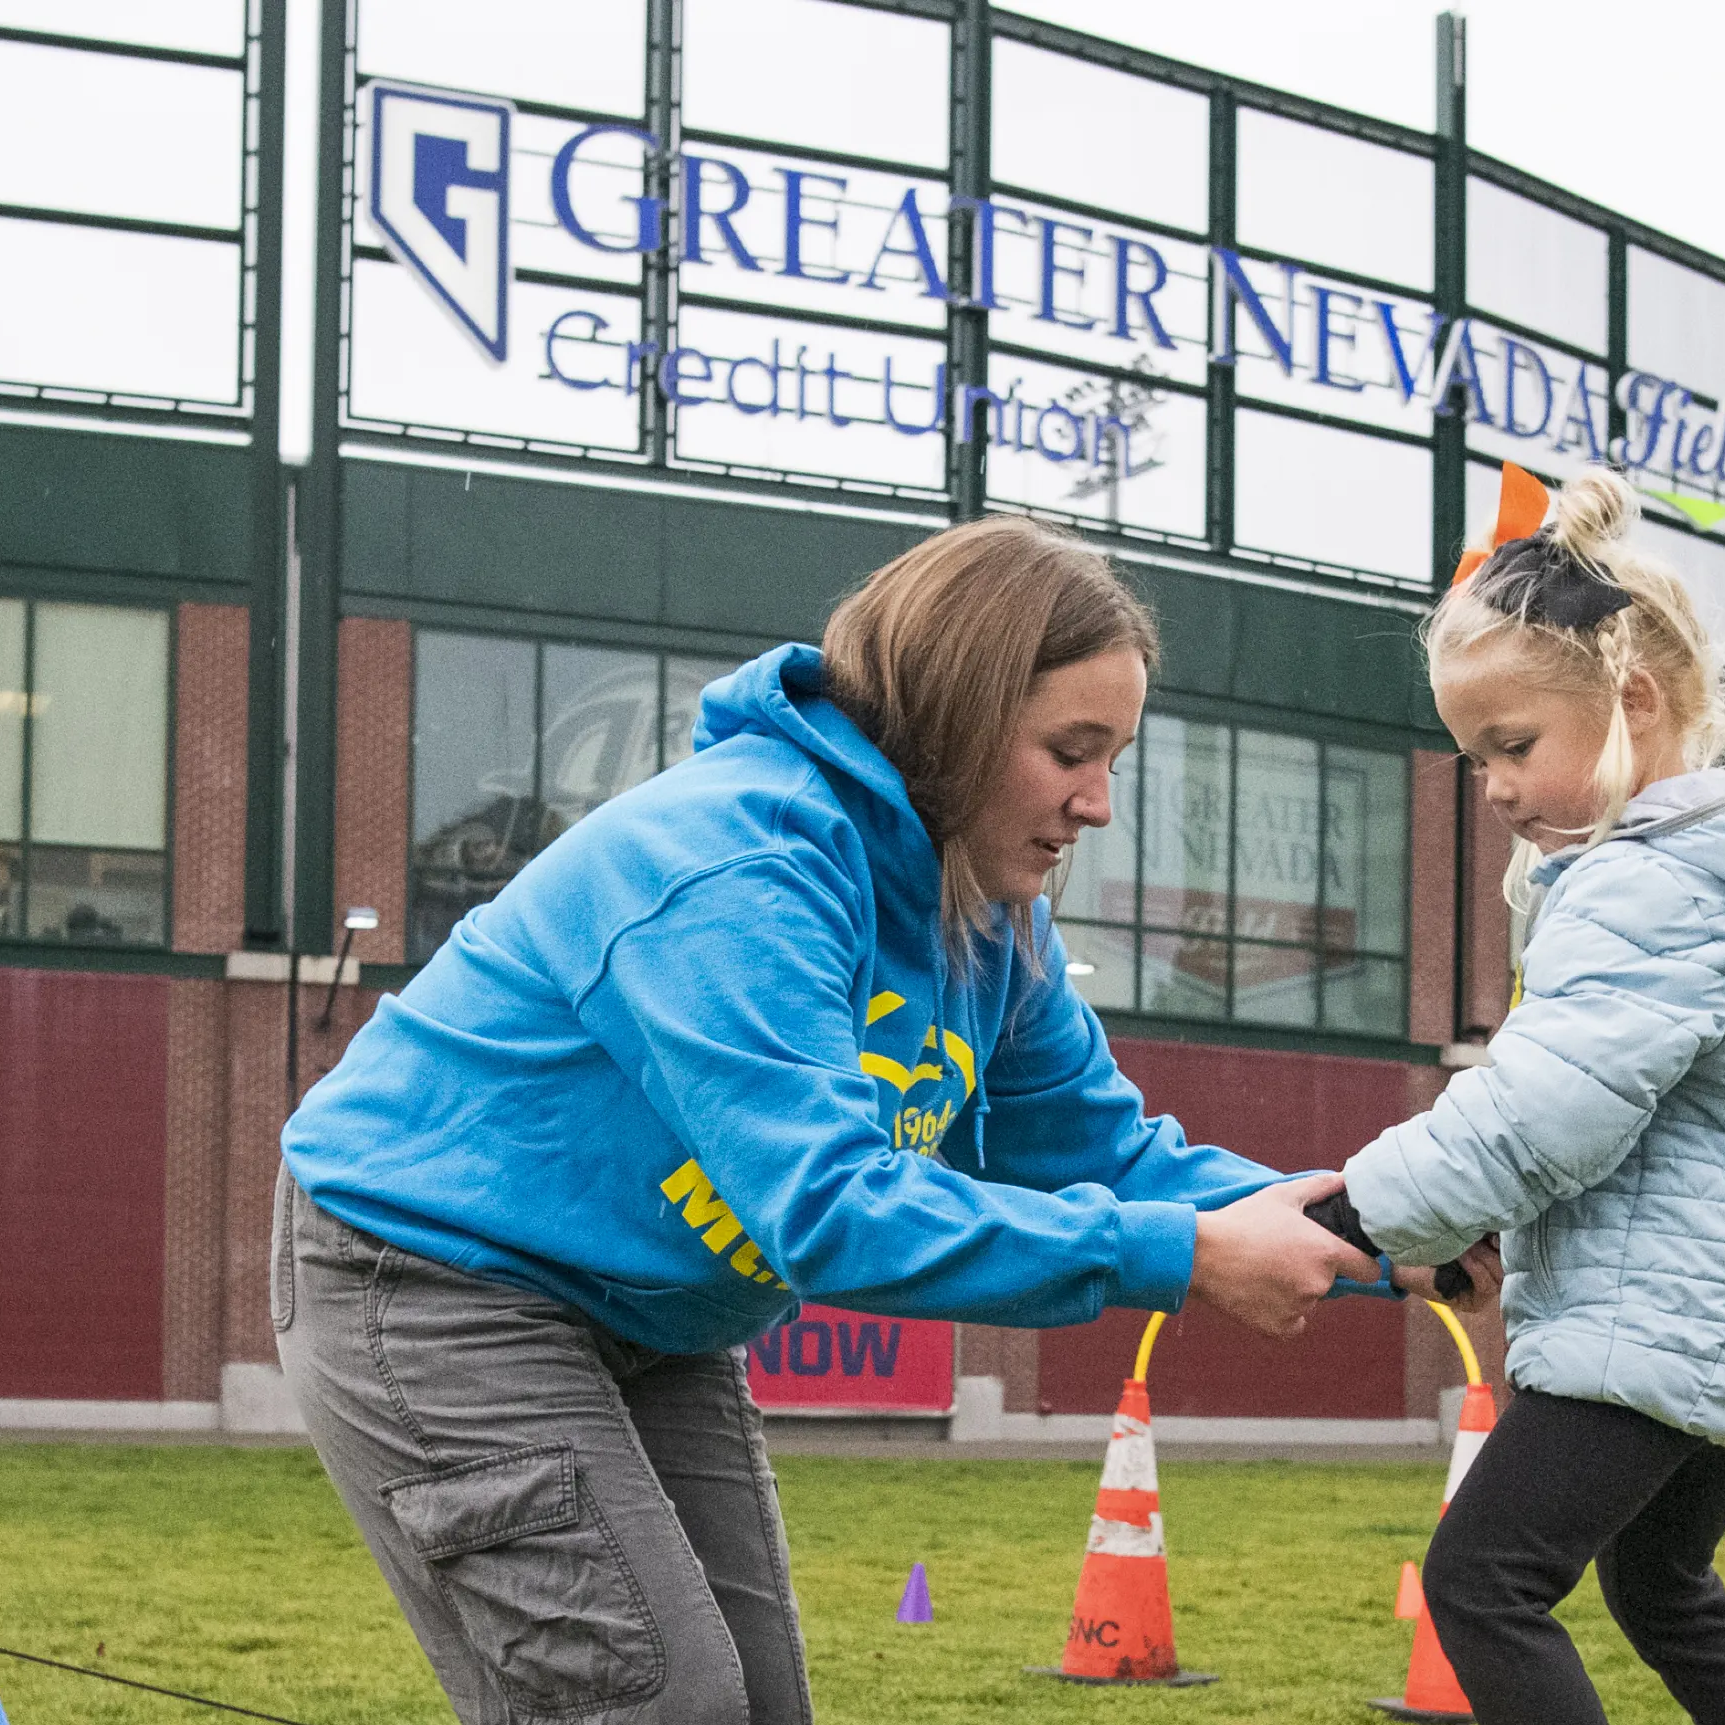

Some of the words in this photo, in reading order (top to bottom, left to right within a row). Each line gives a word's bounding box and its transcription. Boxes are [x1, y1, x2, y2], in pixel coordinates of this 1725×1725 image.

[550, 123, 1178, 352] GREATER
[1211, 246, 1613, 462] NEVADA
[546, 309, 853, 428] Credit
[883, 354, 1138, 479] Union
[747, 1320, 902, 1378] NOW
